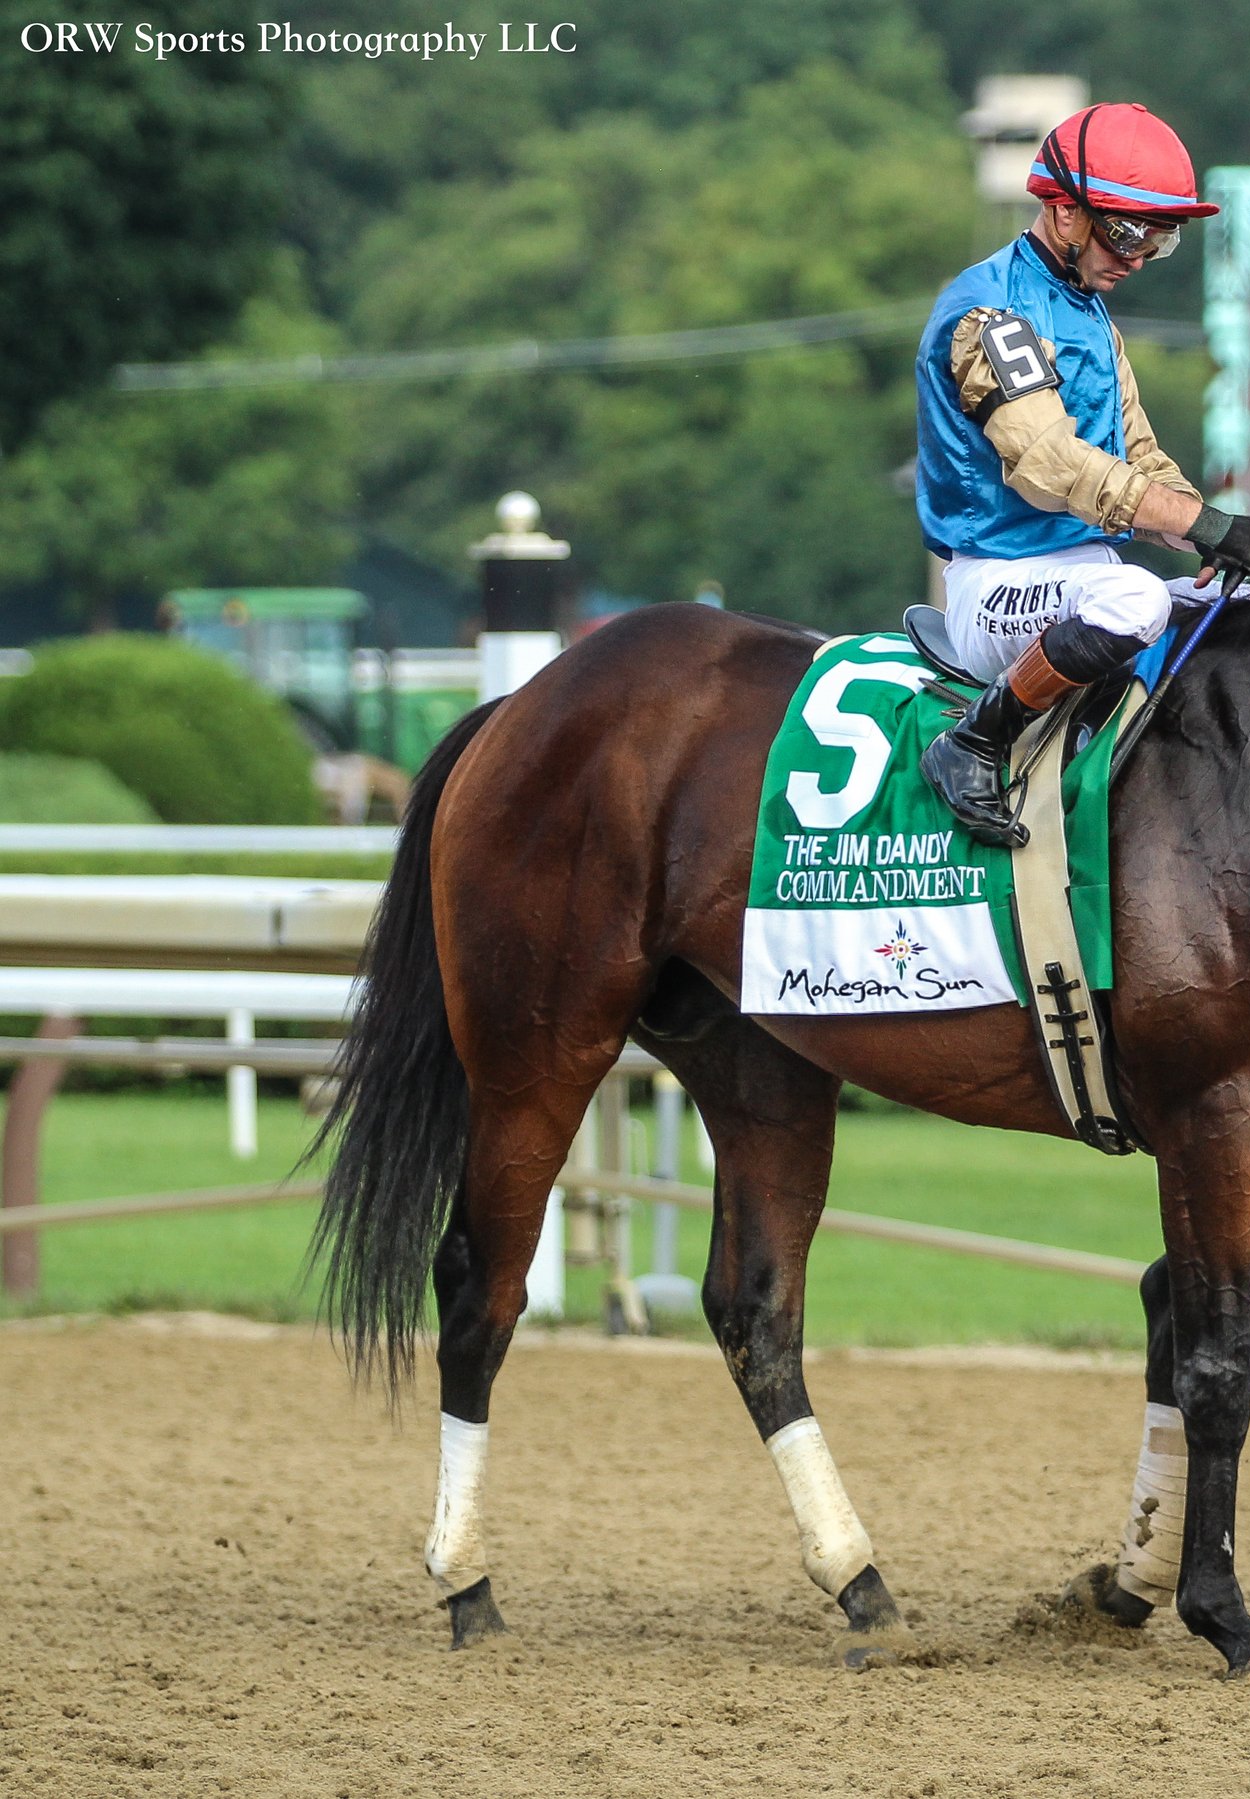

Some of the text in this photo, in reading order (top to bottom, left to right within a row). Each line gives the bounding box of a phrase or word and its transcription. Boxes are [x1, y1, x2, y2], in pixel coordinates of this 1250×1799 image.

[990, 320, 1045, 389] 5
[785, 659, 937, 829] 5
[784, 830, 953, 866] THE JIM DANDY
[776, 866, 985, 902] COMMANDMENT
[778, 968, 984, 1007] Mohegan Sun
